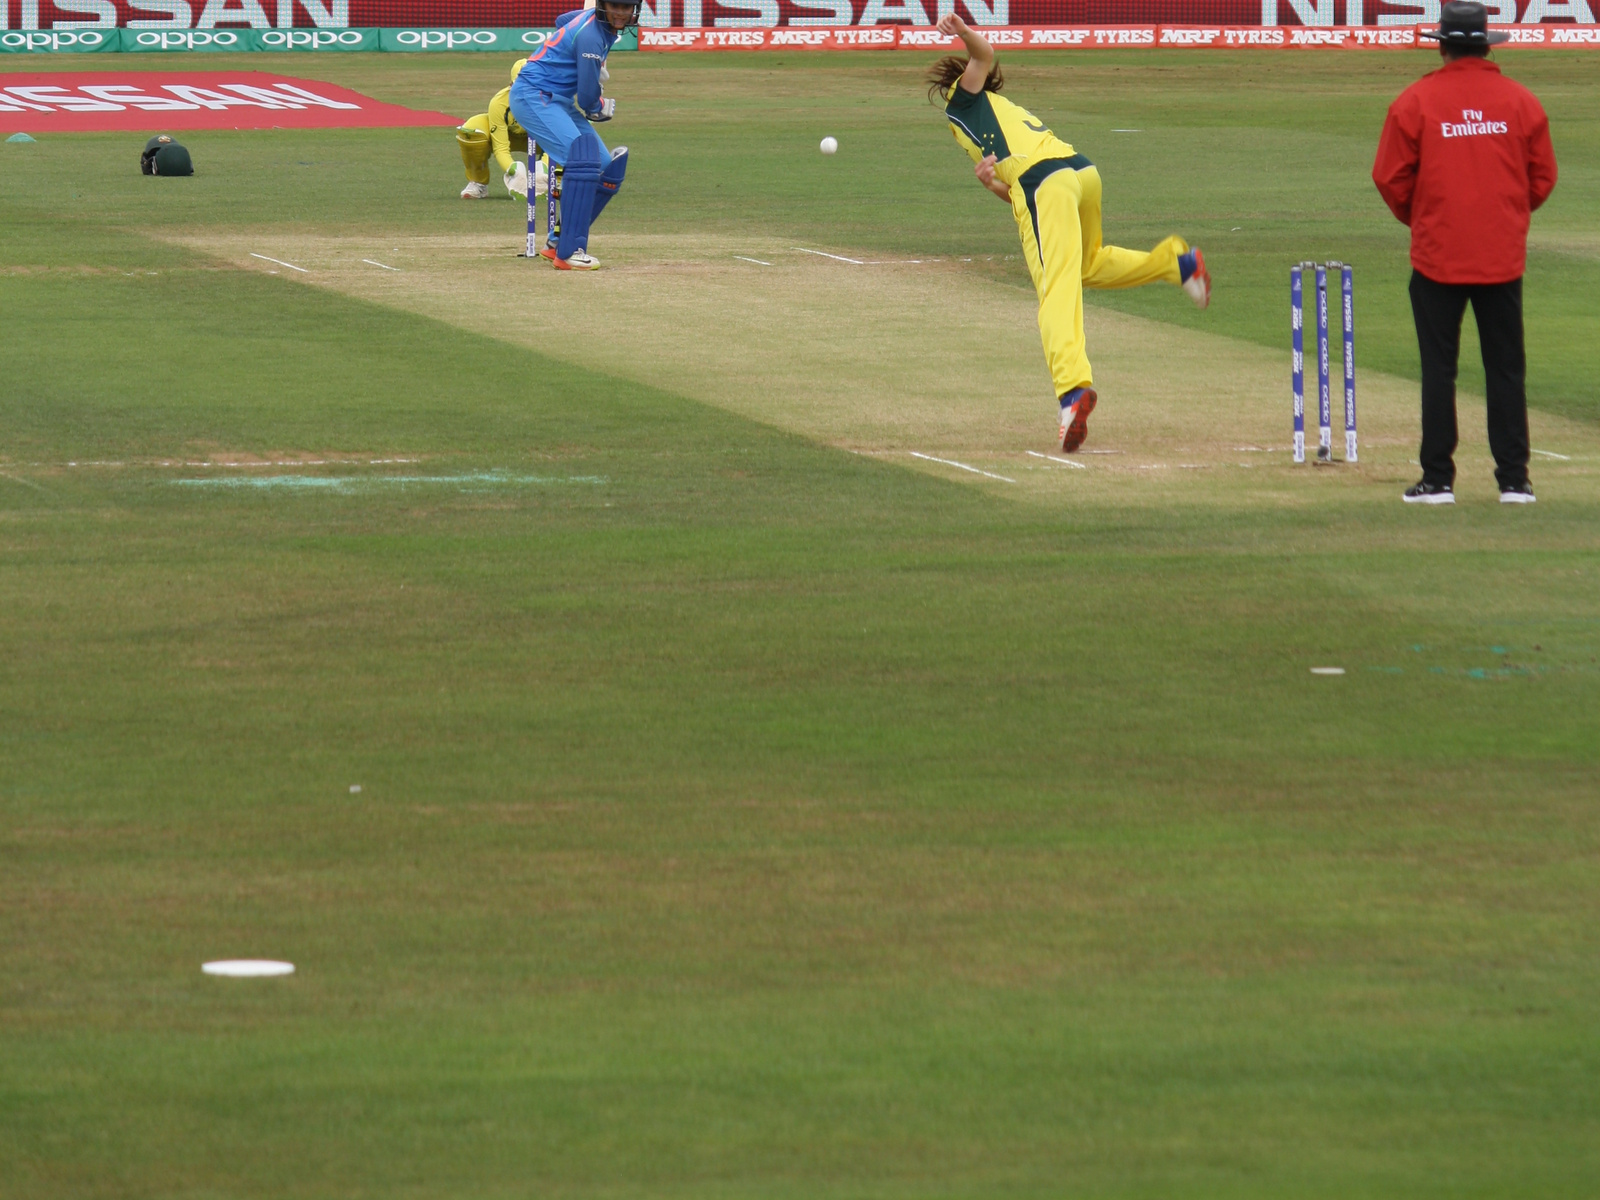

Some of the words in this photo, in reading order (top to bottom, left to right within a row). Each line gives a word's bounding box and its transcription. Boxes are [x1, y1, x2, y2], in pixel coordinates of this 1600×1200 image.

[2, 32, 103, 49] oppo
[137, 32, 237, 49] oppo
[262, 31, 362, 48] oppo
[397, 31, 497, 48] oppo
[641, 31, 700, 45] MRF
[705, 31, 764, 44] TYRES
[770, 31, 830, 44] MRF
[835, 30, 894, 44] TYRES
[1029, 30, 1090, 44] MRF
[1094, 30, 1154, 43] TYRES
[1160, 29, 1220, 43] MRF
[1224, 30, 1284, 44] TYRES
[1290, 30, 1350, 44] MRF
[1355, 30, 1414, 44] TYRES
[0, 84, 362, 112] ISSAN
[1463, 109, 1482, 121] Fly
[1441, 121, 1507, 137] Emirates
[1344, 294, 1352, 332] NISSAN
[1346, 388, 1354, 427] NISSAN
